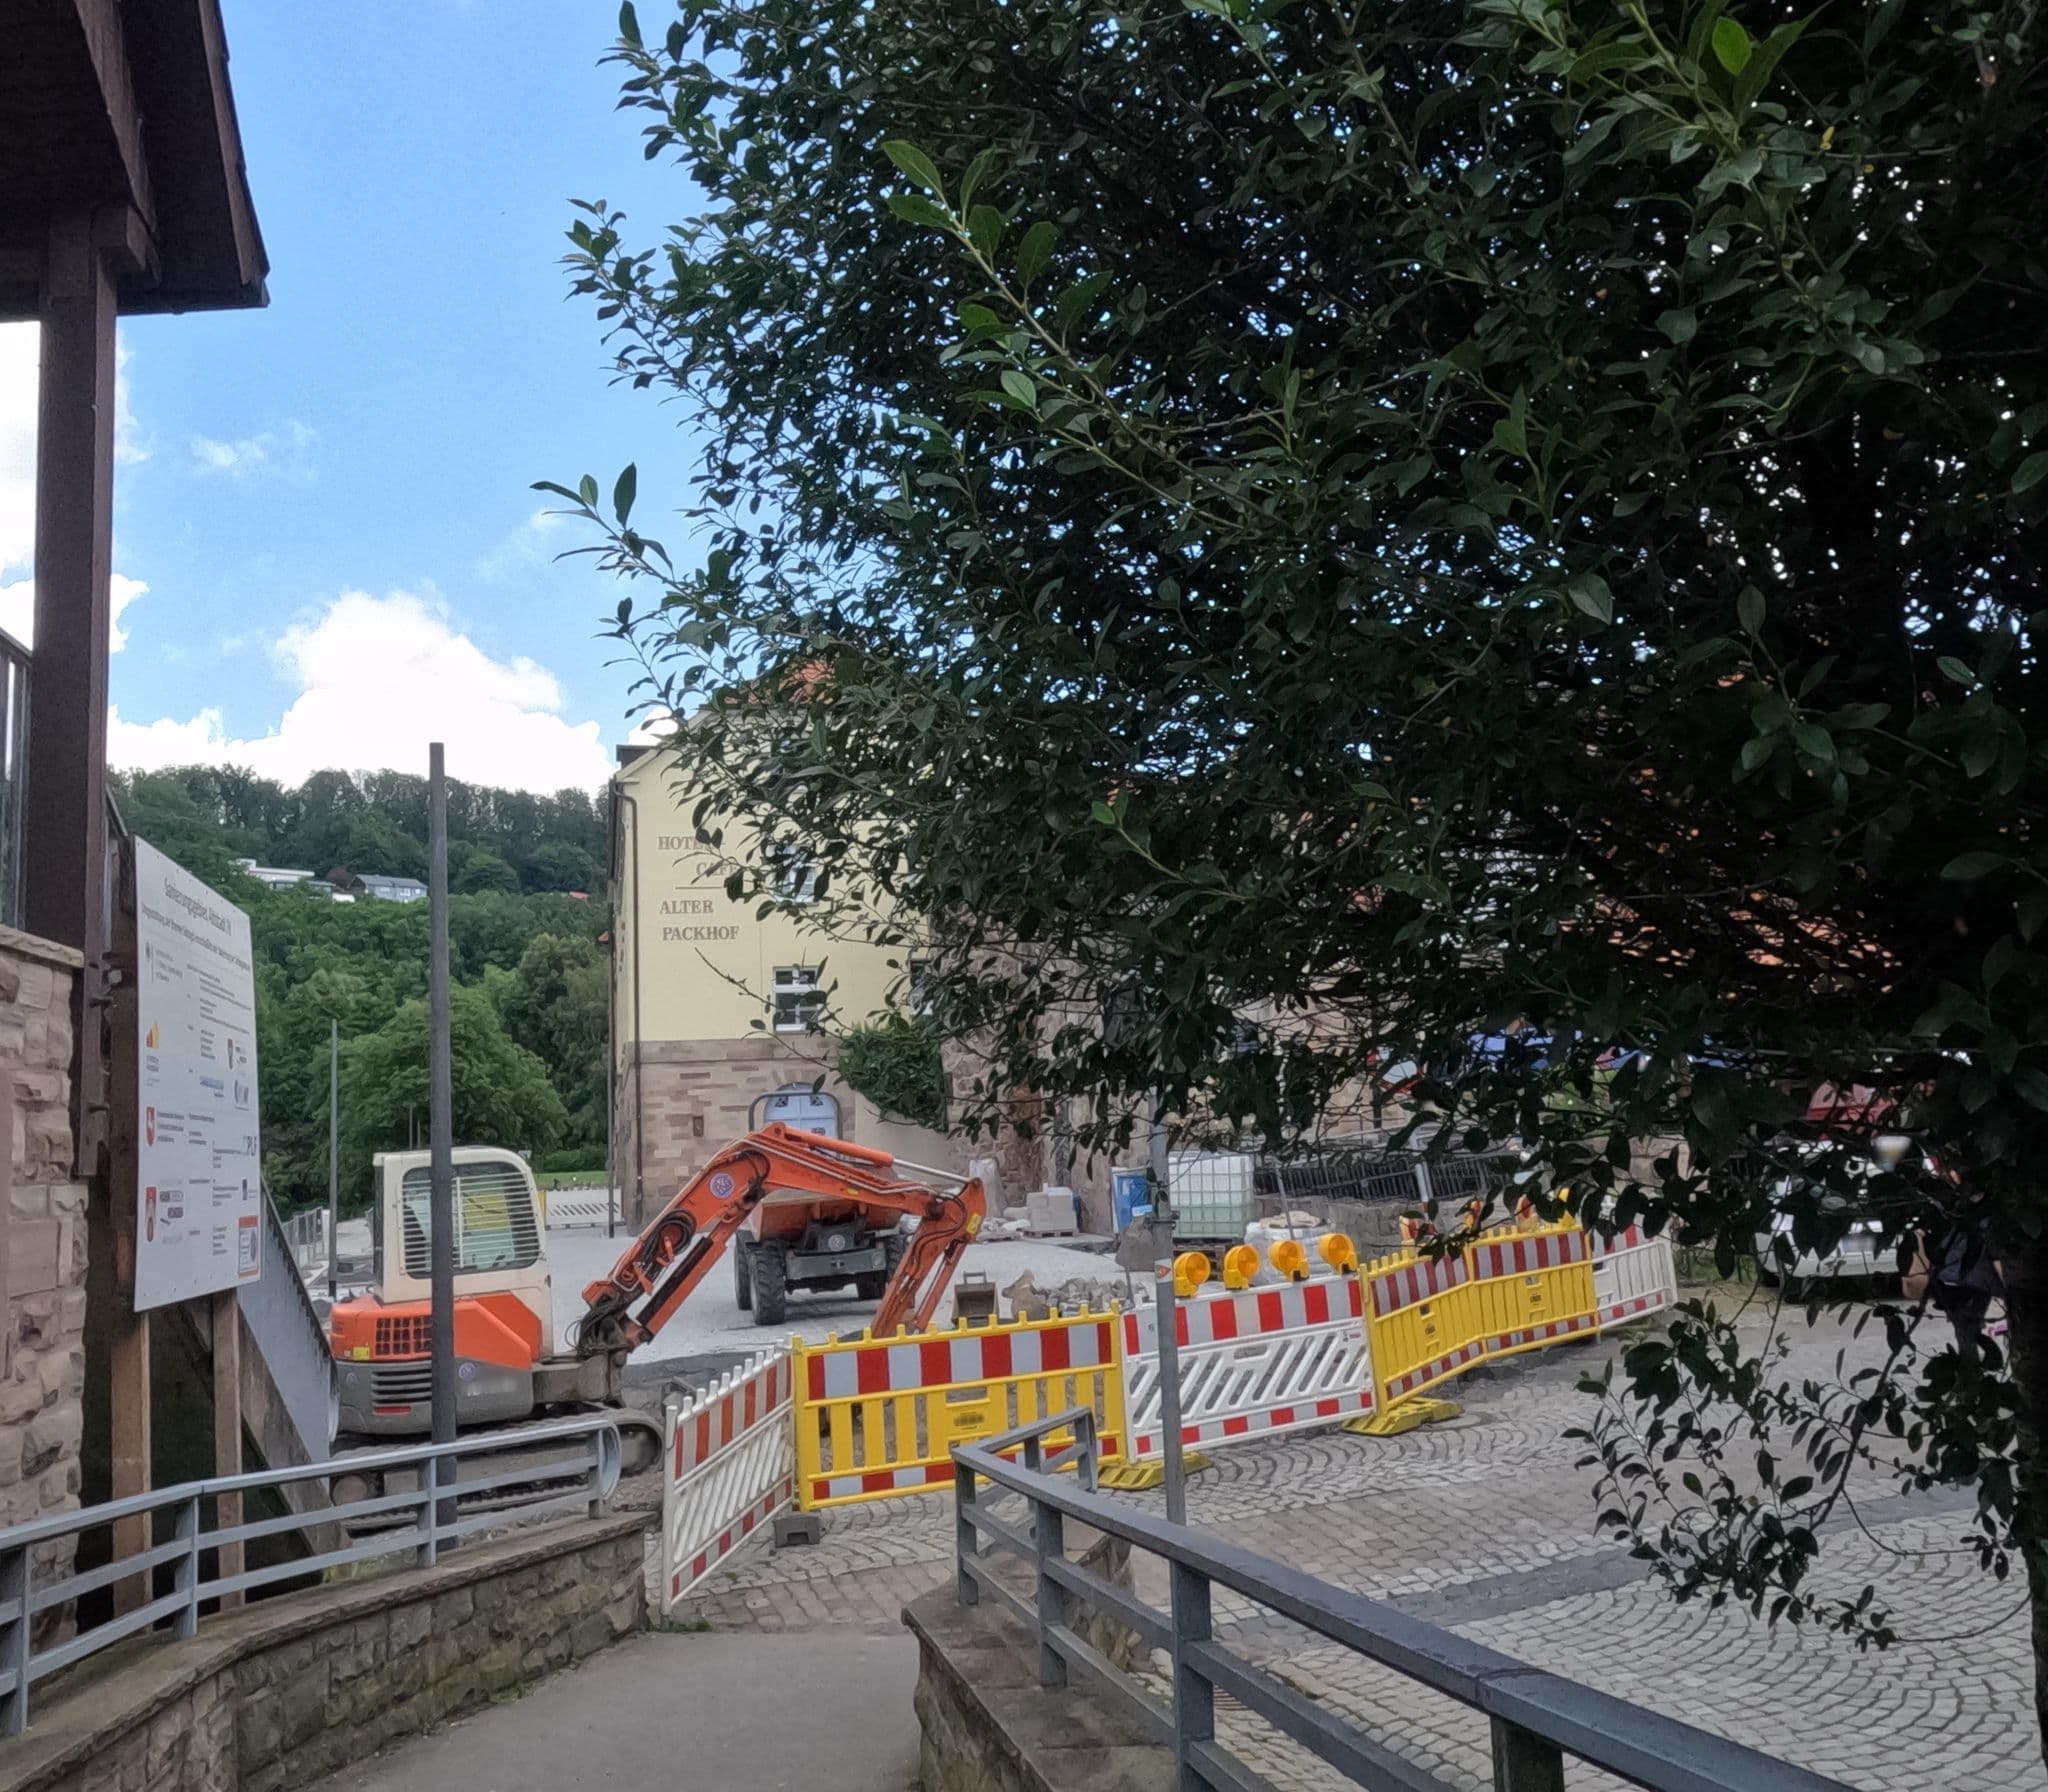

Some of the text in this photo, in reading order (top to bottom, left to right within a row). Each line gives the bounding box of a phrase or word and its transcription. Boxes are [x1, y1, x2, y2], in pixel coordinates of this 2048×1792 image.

[657, 835, 714, 850] HOTE
[660, 900, 714, 914] ALTER
[662, 926, 740, 941] PACKHOF
